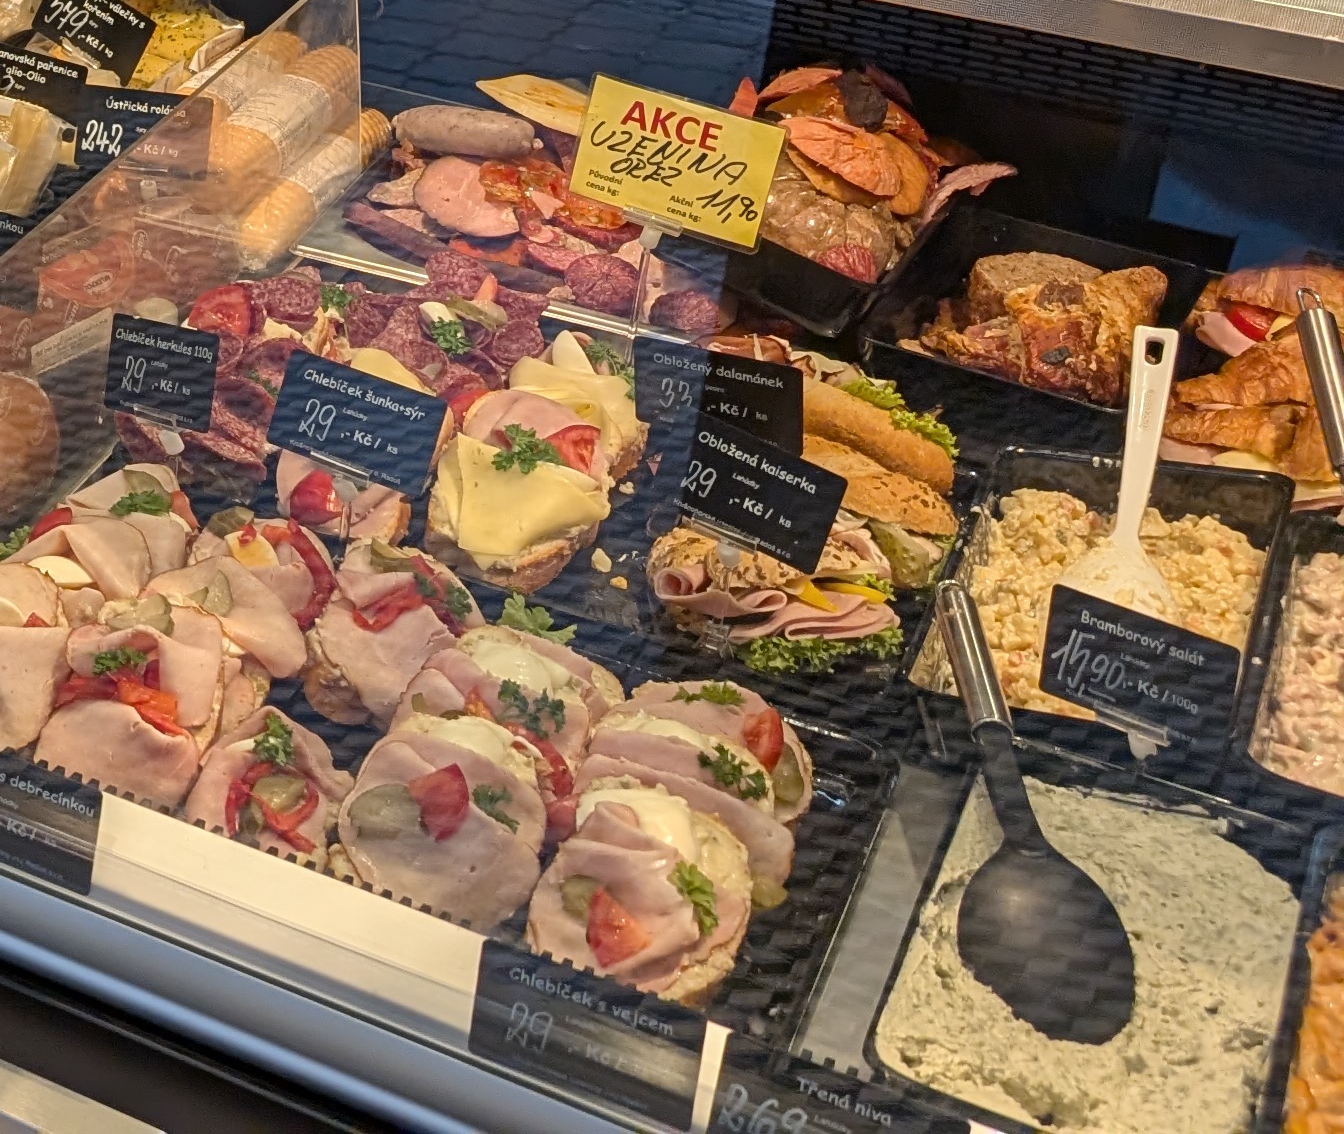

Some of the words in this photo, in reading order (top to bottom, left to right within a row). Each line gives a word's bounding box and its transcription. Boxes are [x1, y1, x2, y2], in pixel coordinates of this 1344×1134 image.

[105, 95, 149, 114] Ústřická
[81, 118, 123, 158] 242
[620, 100, 724, 152] AKCE
[590, 120, 748, 186] UZENINA
[585, 181, 606, 192] cena
[606, 185, 620, 197] kg:
[669, 194, 694, 208] Akční
[666, 206, 688, 218] cena
[688, 210, 702, 223] kg:
[115, 327, 156, 349] Chlebíček
[193, 345, 214, 363] 110g
[653, 352, 713, 376] Obložený
[715, 366, 784, 389] dalamánek
[304, 368, 363, 400] Chlebíček
[364, 389, 426, 422] šunka+sýr
[720, 401, 740, 417] Kč
[352, 429, 374, 447] Kč
[698, 431, 759, 467] Obložená
[760, 457, 816, 495] kaiserka
[680, 460, 717, 498] 29
[742, 497, 764, 516] Kč
[1081, 610, 1166, 655] Bramborový
[1168, 646, 1205, 666] salát
[1137, 679, 1159, 700] Kč
[10, 775, 95, 818] debrecínkou
[509, 966, 593, 1007] Chlebíček
[596, 997, 607, 1013] s
[612, 1004, 674, 1038] vejcem
[797, 1075, 852, 1109] Třená
[855, 1100, 893, 1128] niva
